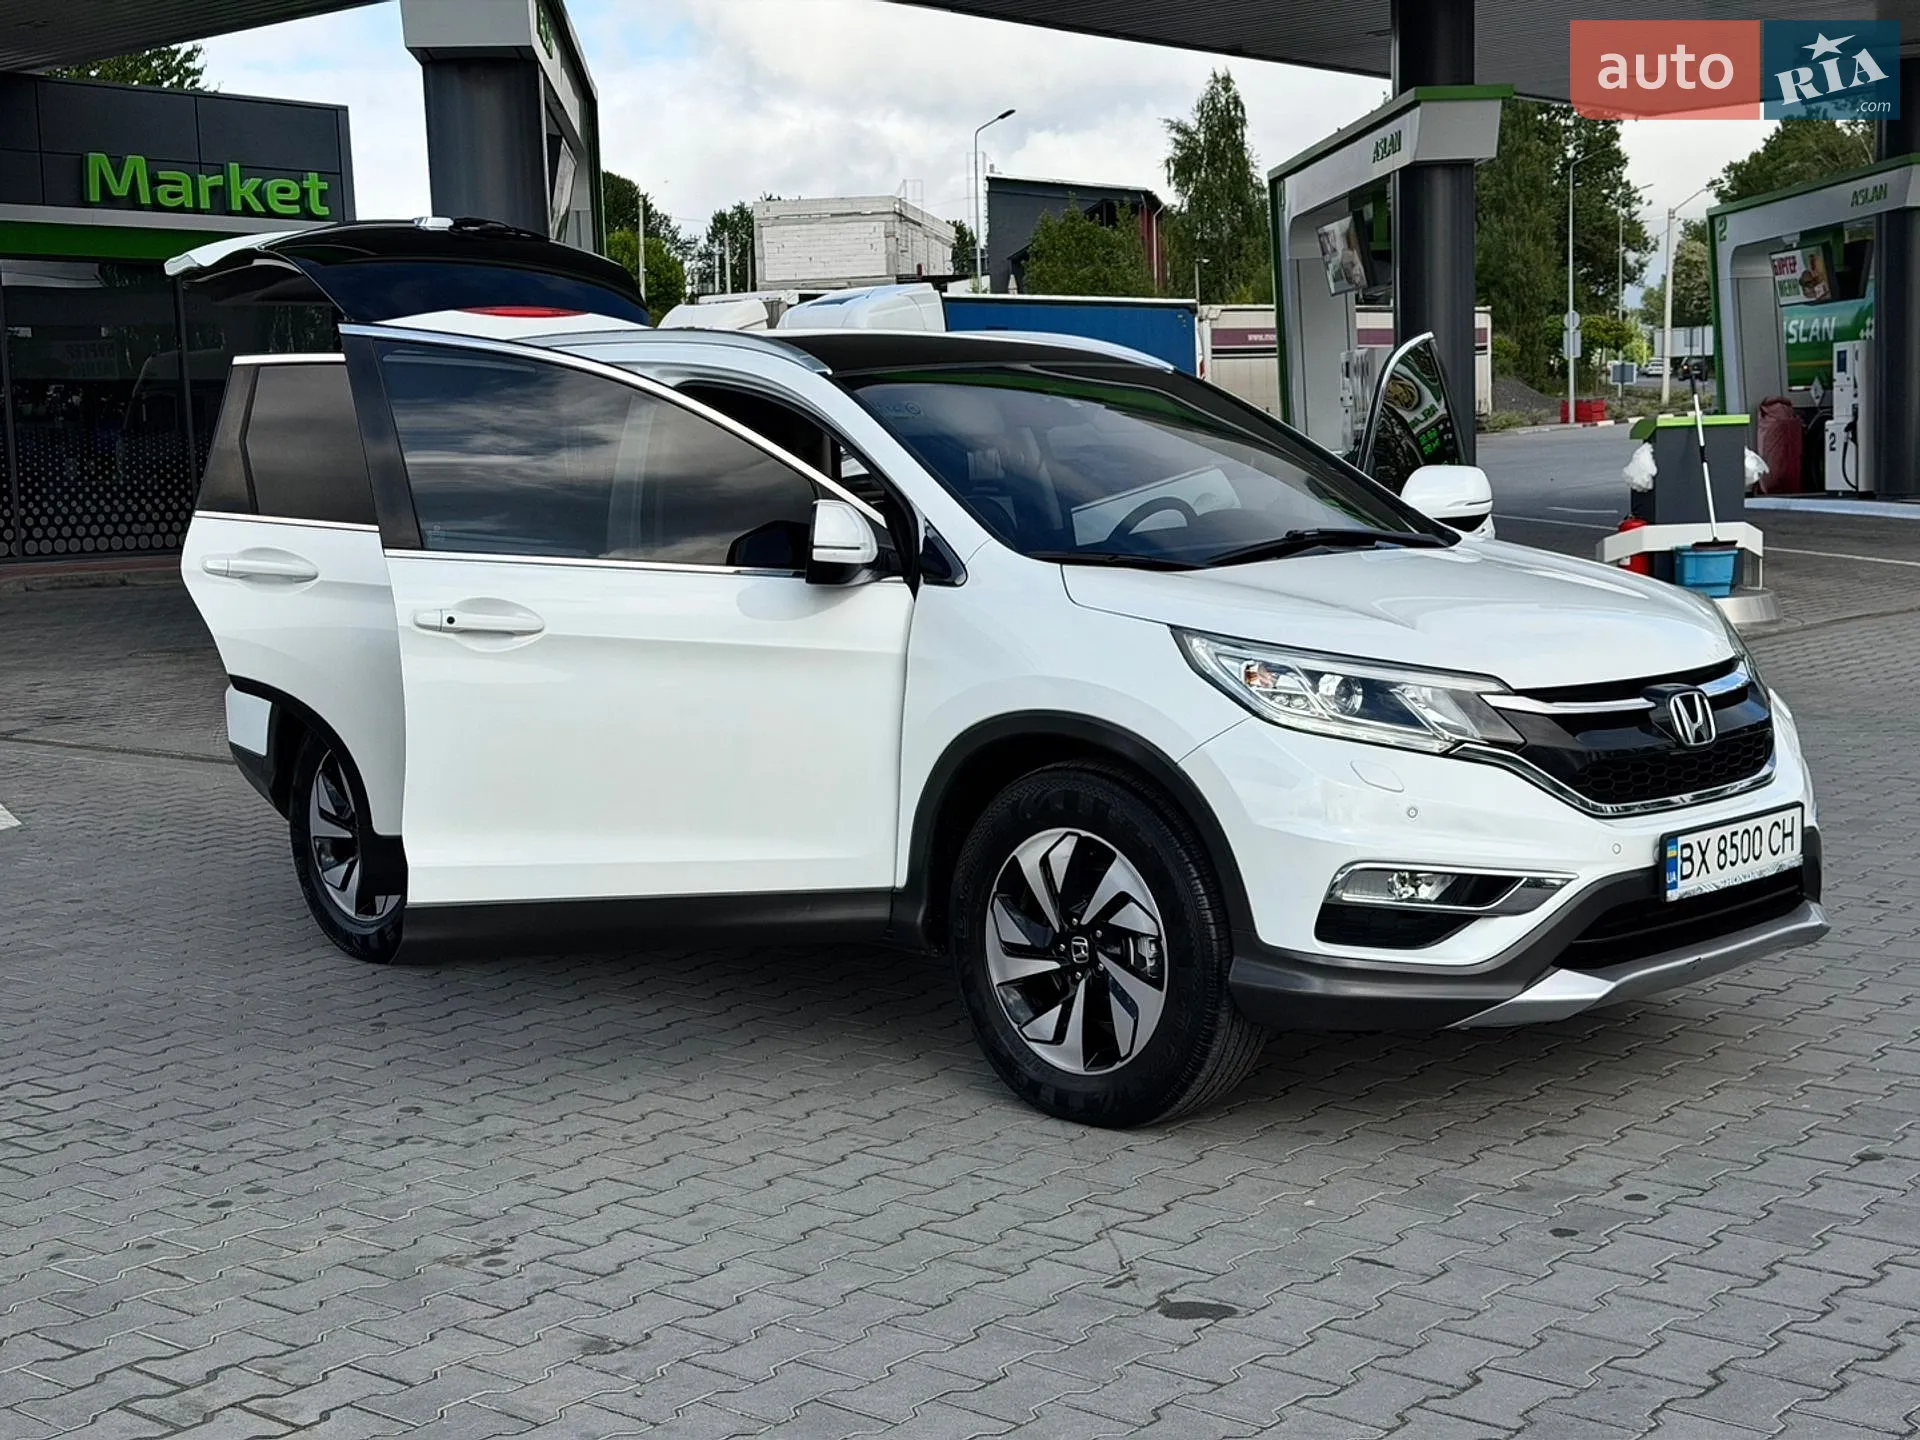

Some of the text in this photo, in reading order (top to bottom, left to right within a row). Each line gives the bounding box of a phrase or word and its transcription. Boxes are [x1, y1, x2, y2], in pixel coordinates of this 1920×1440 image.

[1372, 130, 1402, 164] ASLAN
[86, 152, 330, 217] Market
[1850, 183, 1888, 208] ASLAN
[1718, 215, 1728, 242] 2
[1829, 432, 1836, 451] 2
[1680, 837, 1710, 881] BX
[1717, 825, 1763, 870] 8500
[1768, 816, 1795, 856] CH
[1666, 870, 1677, 884] UA
